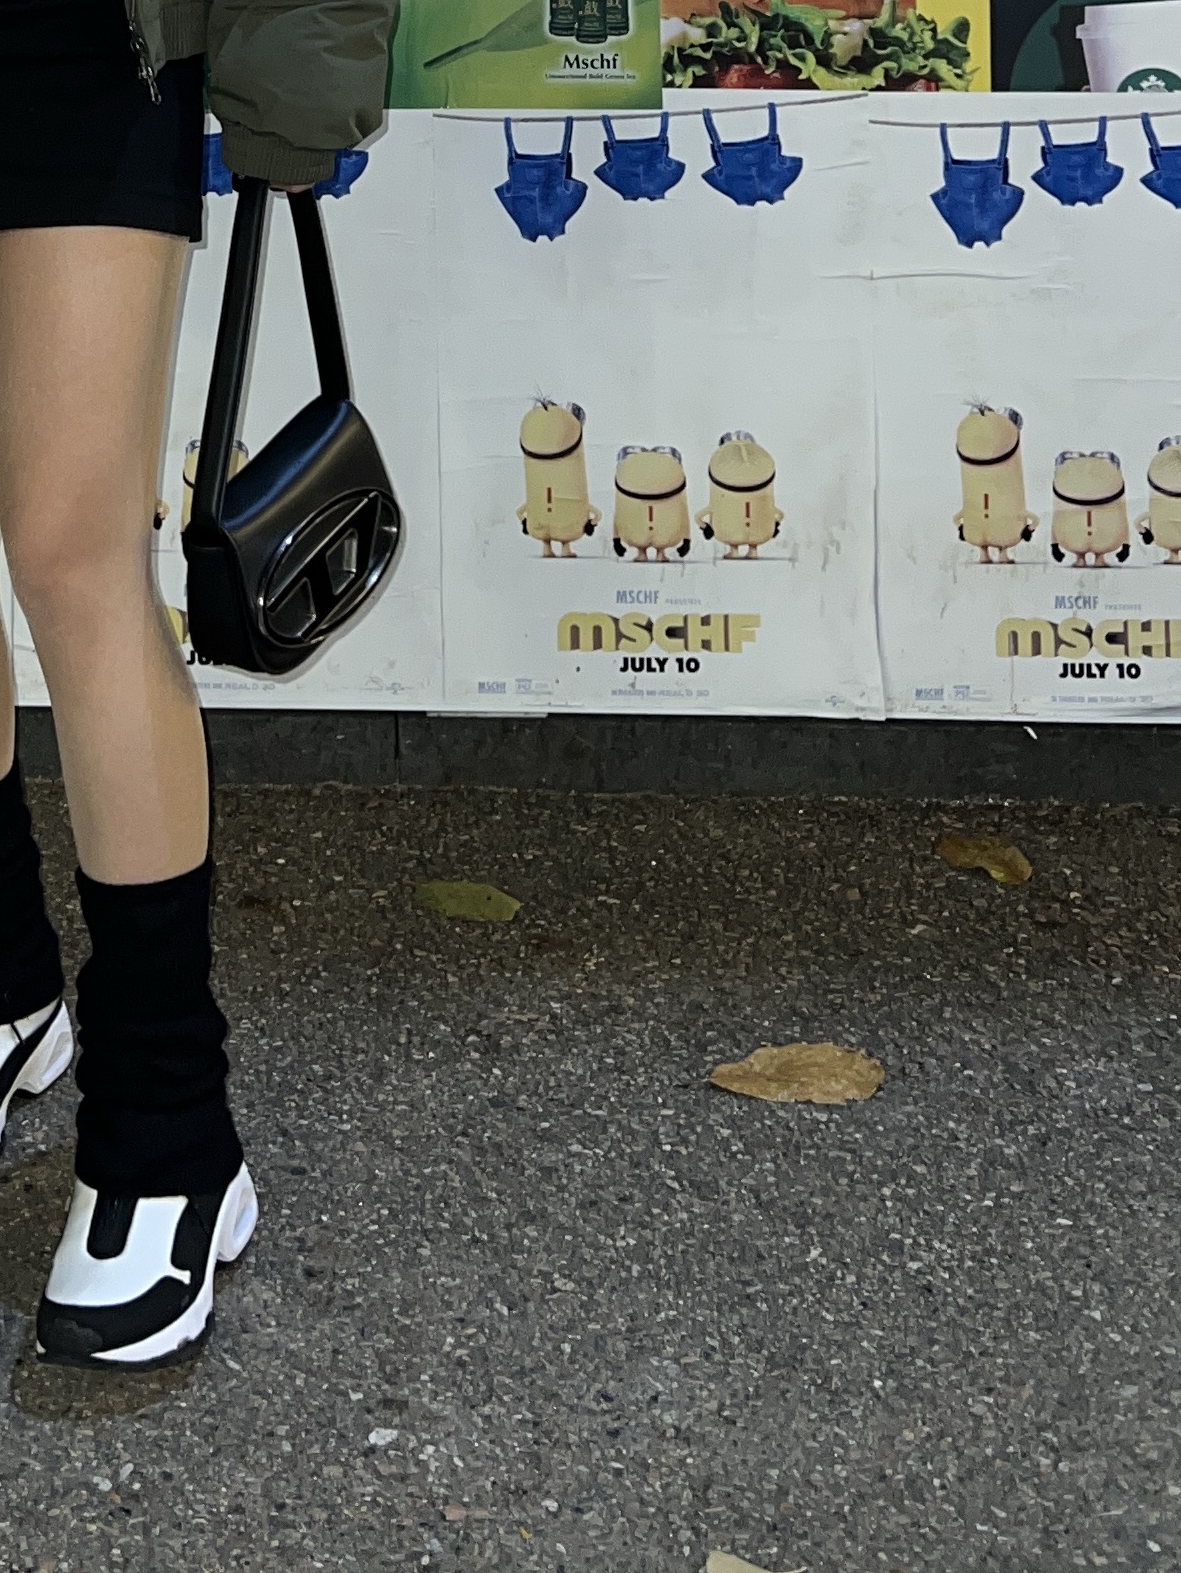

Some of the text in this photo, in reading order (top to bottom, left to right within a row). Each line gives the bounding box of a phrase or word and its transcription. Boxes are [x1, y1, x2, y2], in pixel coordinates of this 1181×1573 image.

[563, 53, 619, 70] Mschf
[615, 590, 660, 604] MSCHF
[1054, 595, 1099, 610] MSCHF
[619, 657, 700, 673] JULY 10
[1059, 663, 1141, 679] JULY 10
